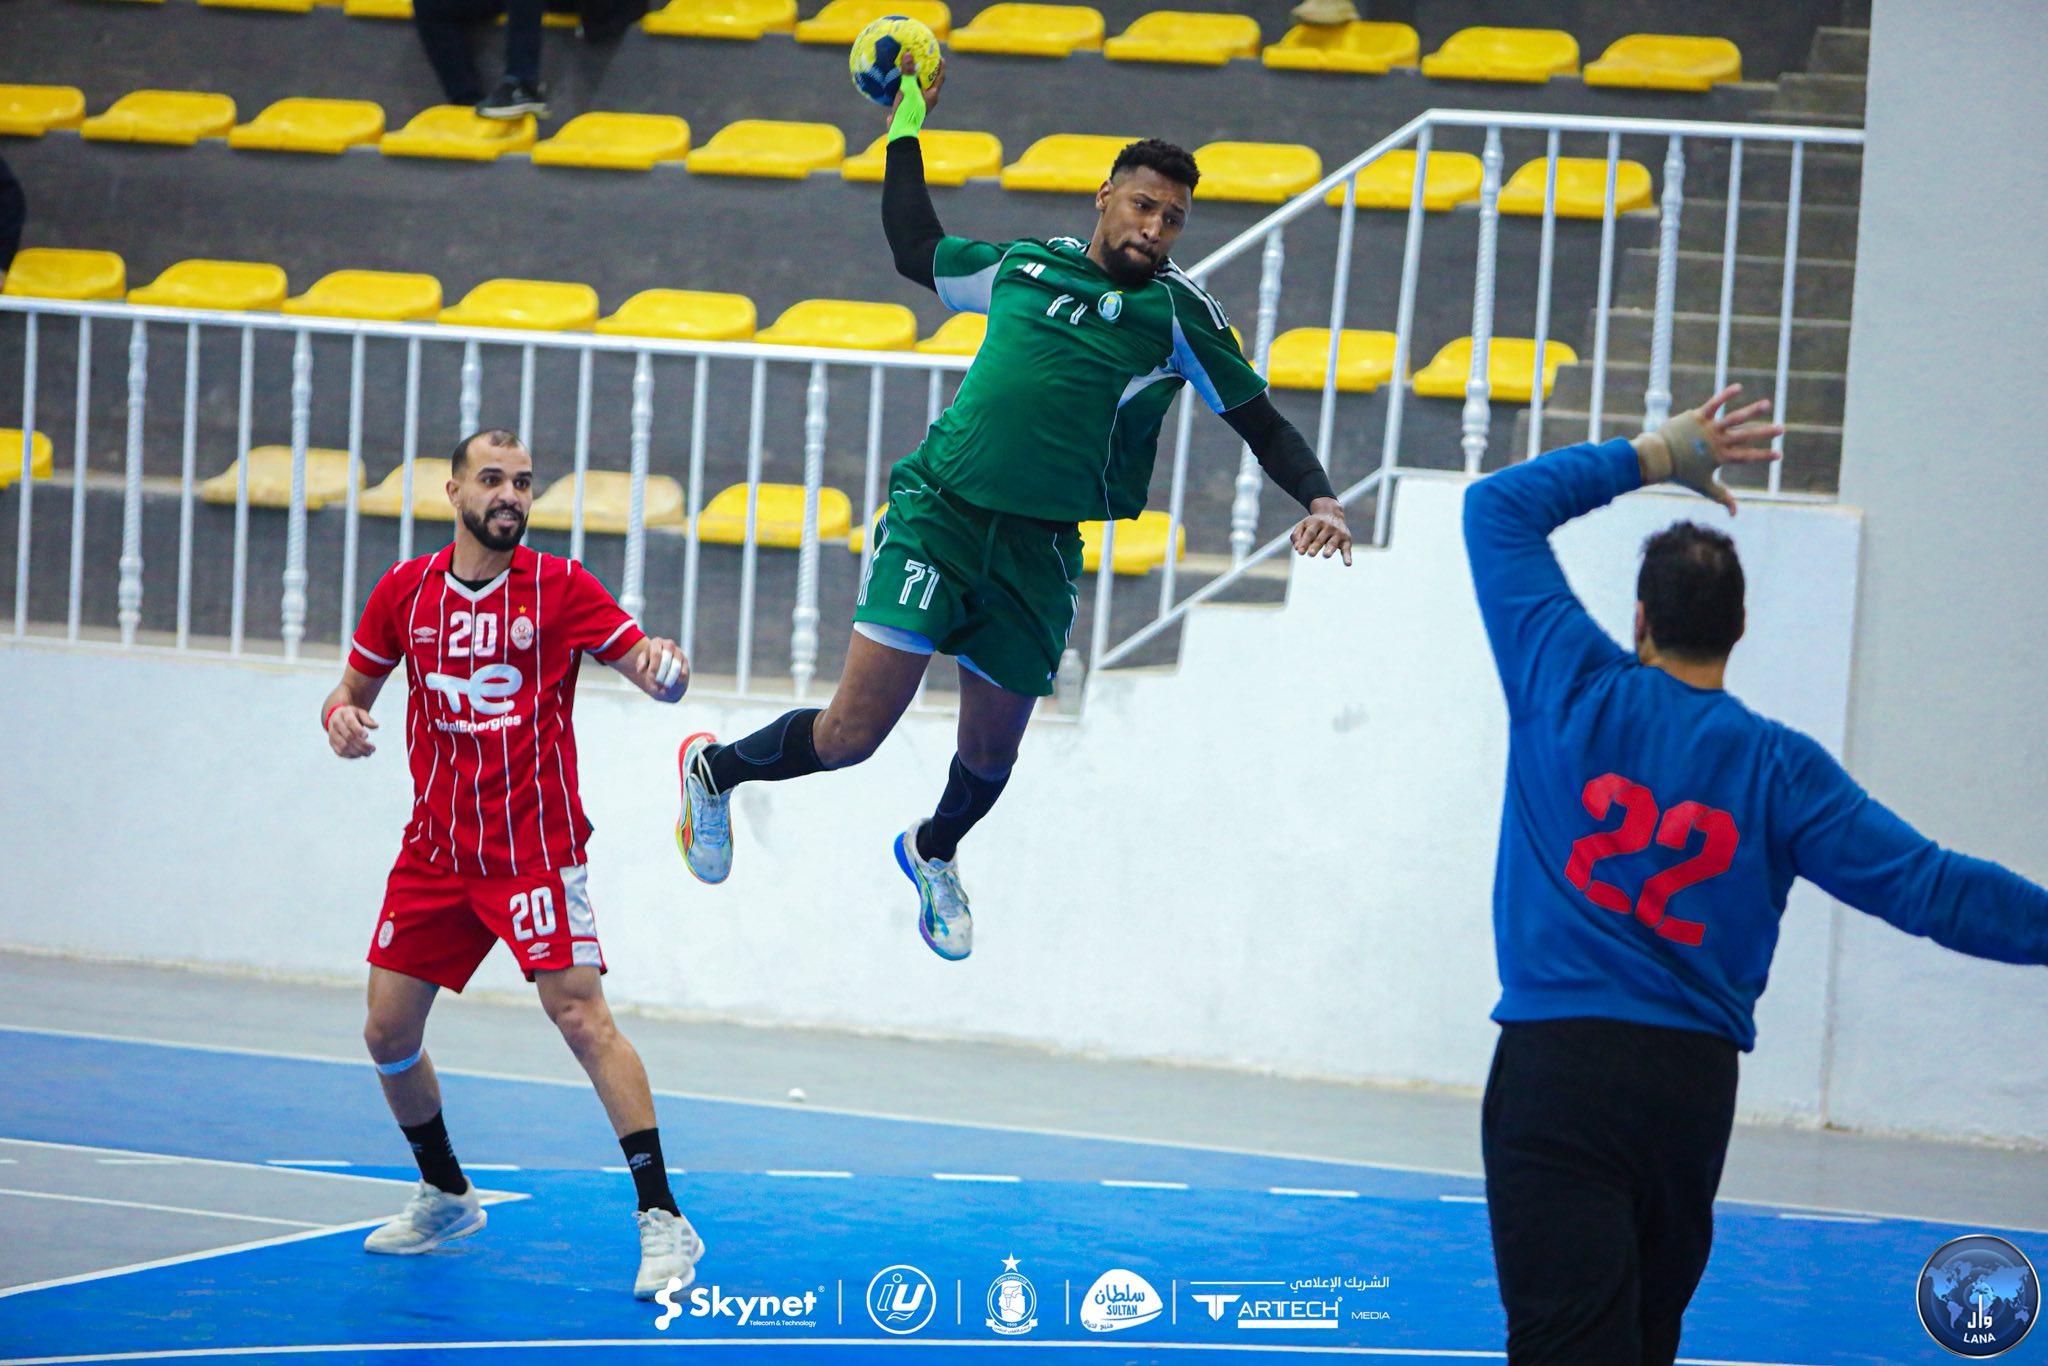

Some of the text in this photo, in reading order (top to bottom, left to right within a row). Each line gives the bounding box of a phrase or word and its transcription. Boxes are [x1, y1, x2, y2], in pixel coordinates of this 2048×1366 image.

[898, 559, 940, 610] 71
[448, 611, 498, 657] 20
[1564, 772, 1740, 946] 22
[509, 886, 556, 941] 20
